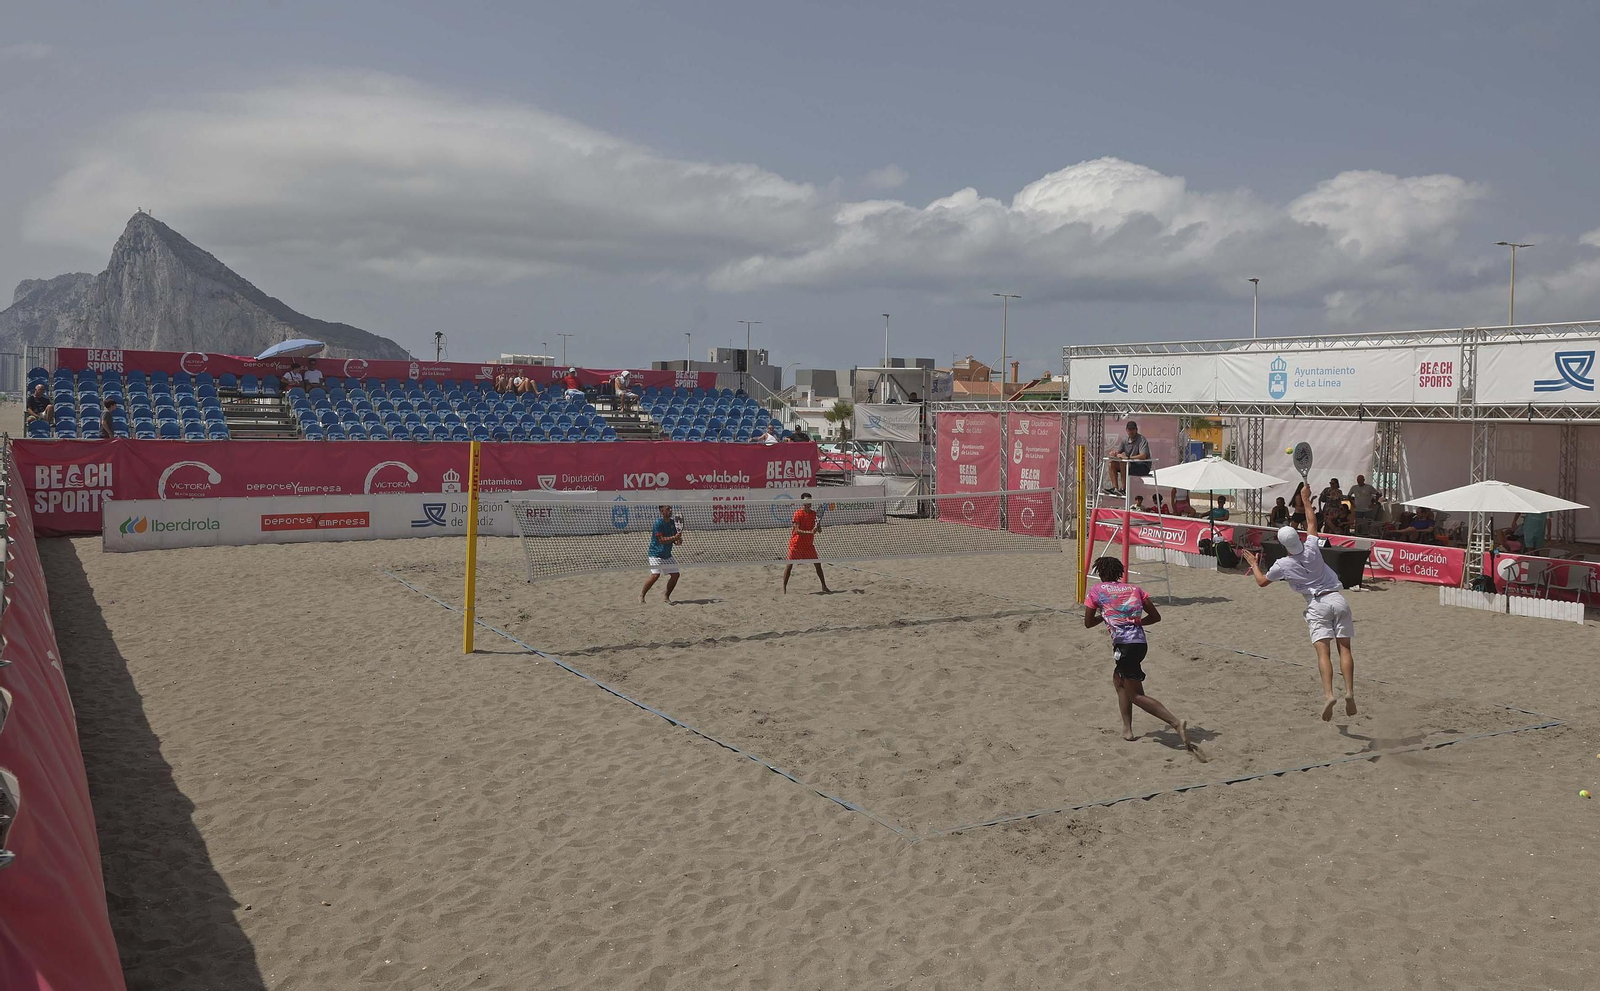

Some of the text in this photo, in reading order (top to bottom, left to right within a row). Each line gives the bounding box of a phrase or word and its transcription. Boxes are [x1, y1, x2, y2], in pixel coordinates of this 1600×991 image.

[87, 349, 123, 362] BEACH
[87, 362, 124, 374] SPORTS
[1132, 364, 1182, 378] Diputación
[1294, 366, 1356, 377] Ayuntamiento
[1420, 361, 1453, 375] BEACH
[675, 370, 699, 380] BEACH
[674, 379, 698, 388] SPORTS
[1294, 377, 1341, 388] de La Línea
[1419, 375, 1453, 388] SPORTS
[1132, 382, 1172, 394] de Cádiz
[1025, 446, 1050, 454] Ayuntamiento
[766, 460, 812, 479] BEACH
[959, 464, 977, 475] BEACH
[1020, 468, 1040, 480] BEACH
[35, 463, 113, 490] BEACH
[468, 478, 522, 486] untamiento
[562, 473, 605, 484] Diputación
[623, 472, 669, 488] KYDO
[699, 470, 750, 483] volabola
[959, 475, 978, 486] SPORTS
[170, 482, 212, 490] VICTORIA
[1019, 479, 1040, 490] SPORTS
[451, 502, 503, 514] Dipación
[451, 516, 463, 527] de
[712, 511, 746, 524] SPORTS
[151, 517, 220, 532] Iberdrola
[1399, 549, 1447, 564] Diputación
[1399, 563, 1439, 577] de Cádiz
